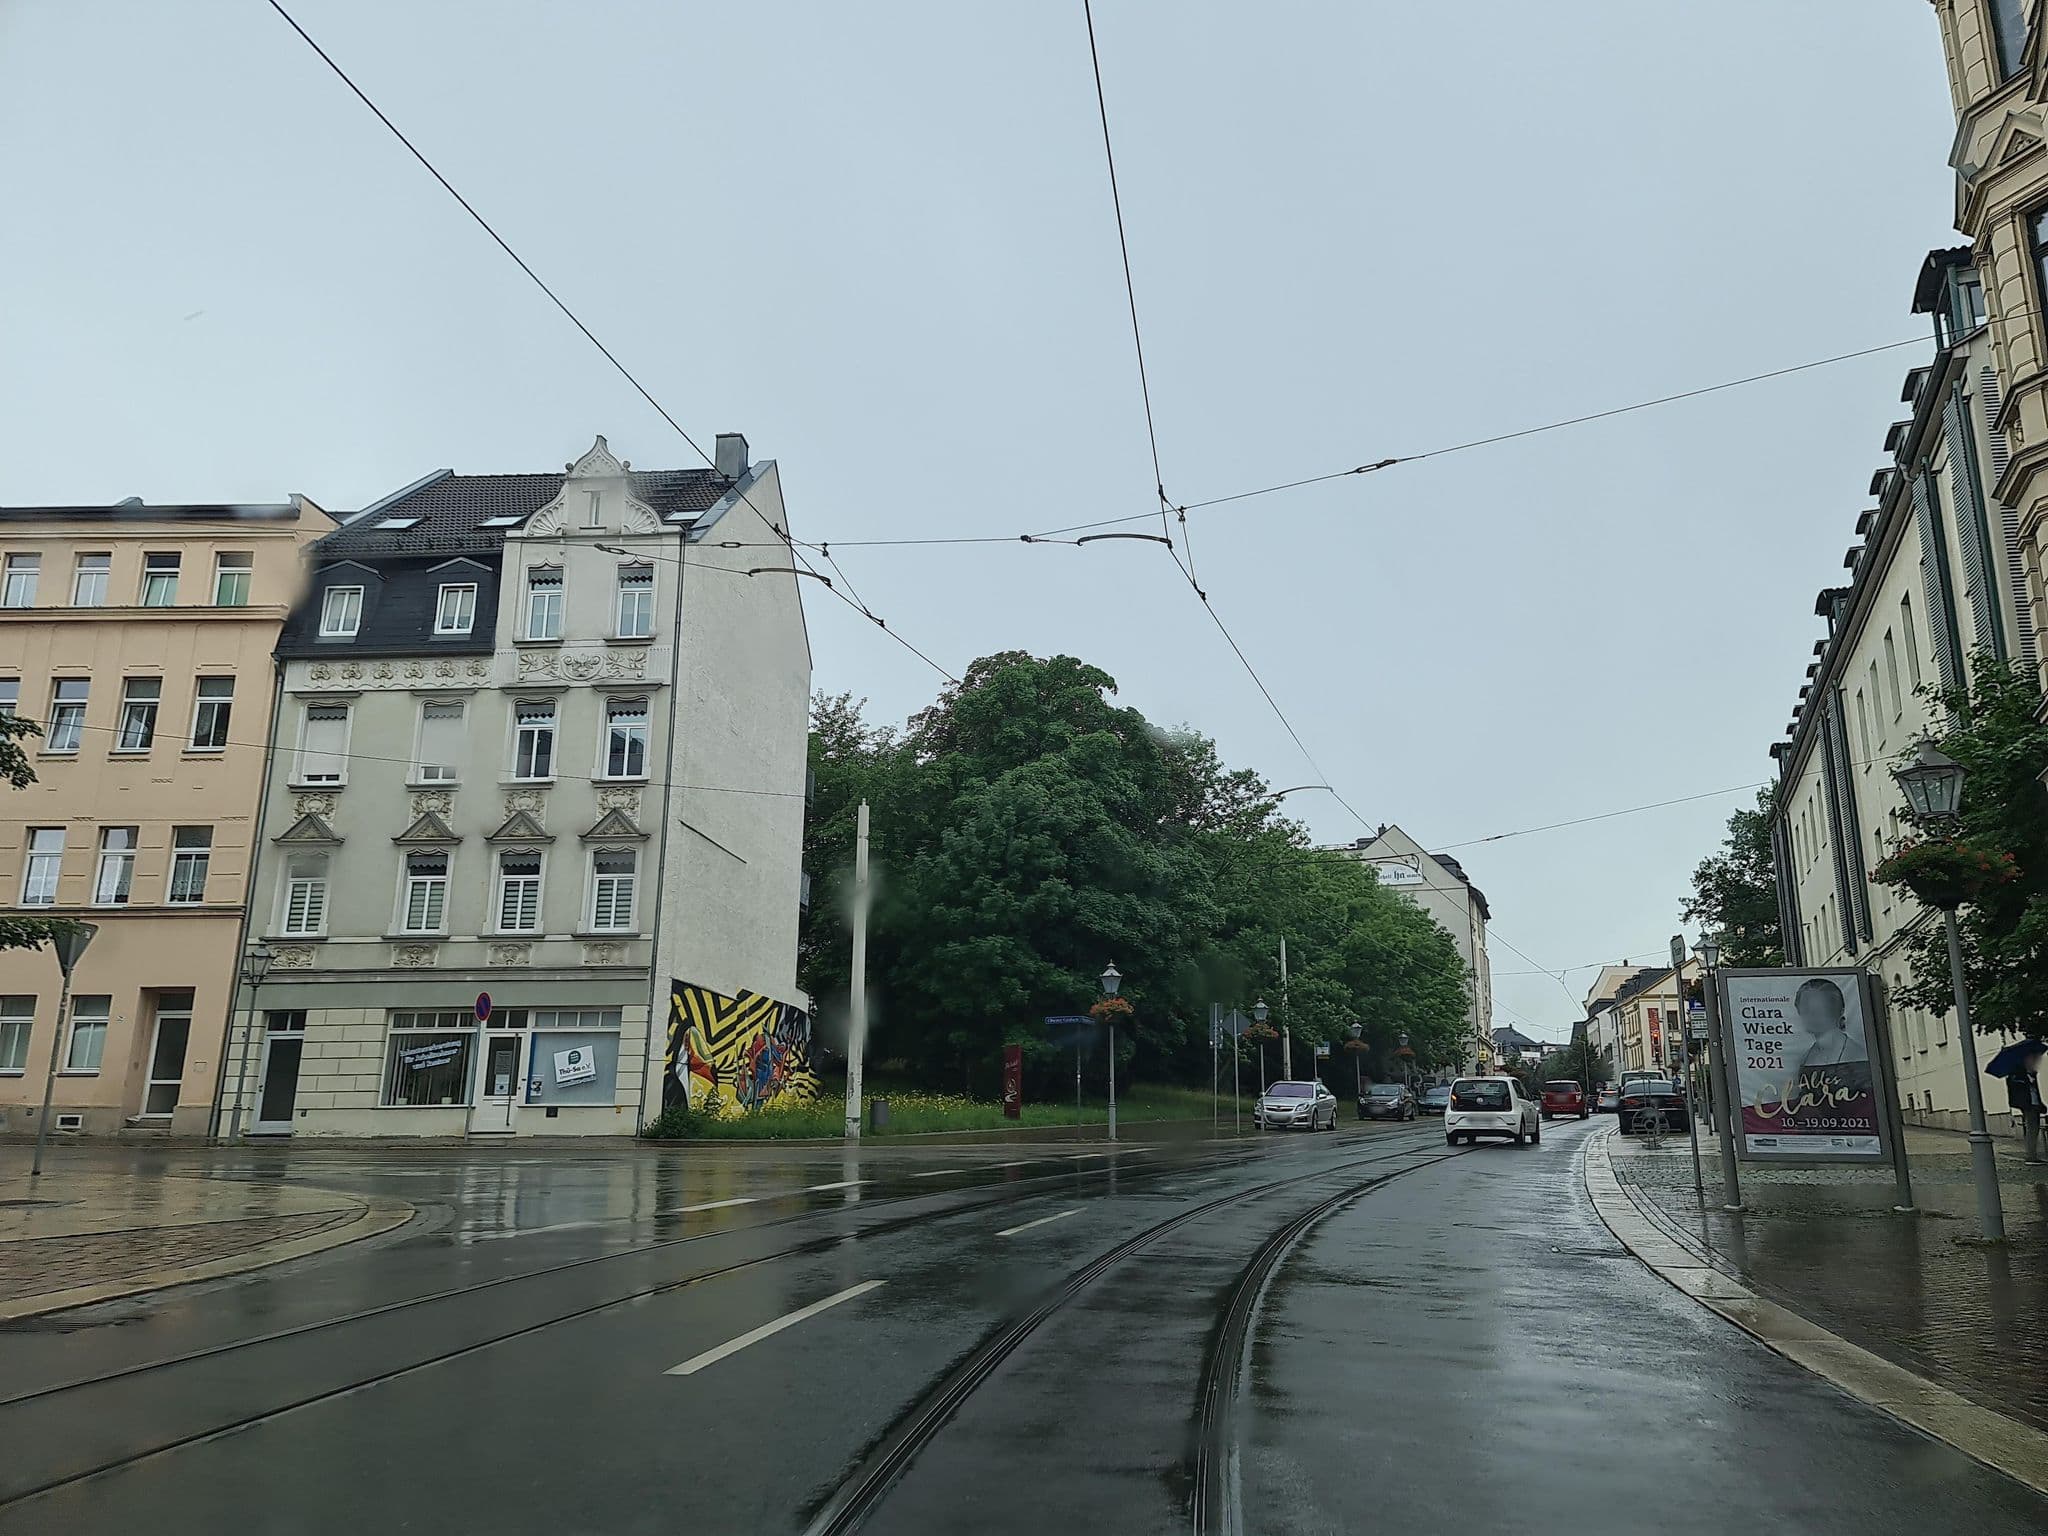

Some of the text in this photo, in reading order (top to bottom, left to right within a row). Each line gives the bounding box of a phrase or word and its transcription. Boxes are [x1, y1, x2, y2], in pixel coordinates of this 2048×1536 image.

[1741, 1006, 1783, 1019] Clara
[1742, 1021, 1794, 1035] Wieck
[1744, 1038, 1783, 1054] Tage
[1747, 1056, 1784, 1069] 2021
[1798, 1071, 1841, 1090] Alles
[1754, 1078, 1867, 1119] Clara.
